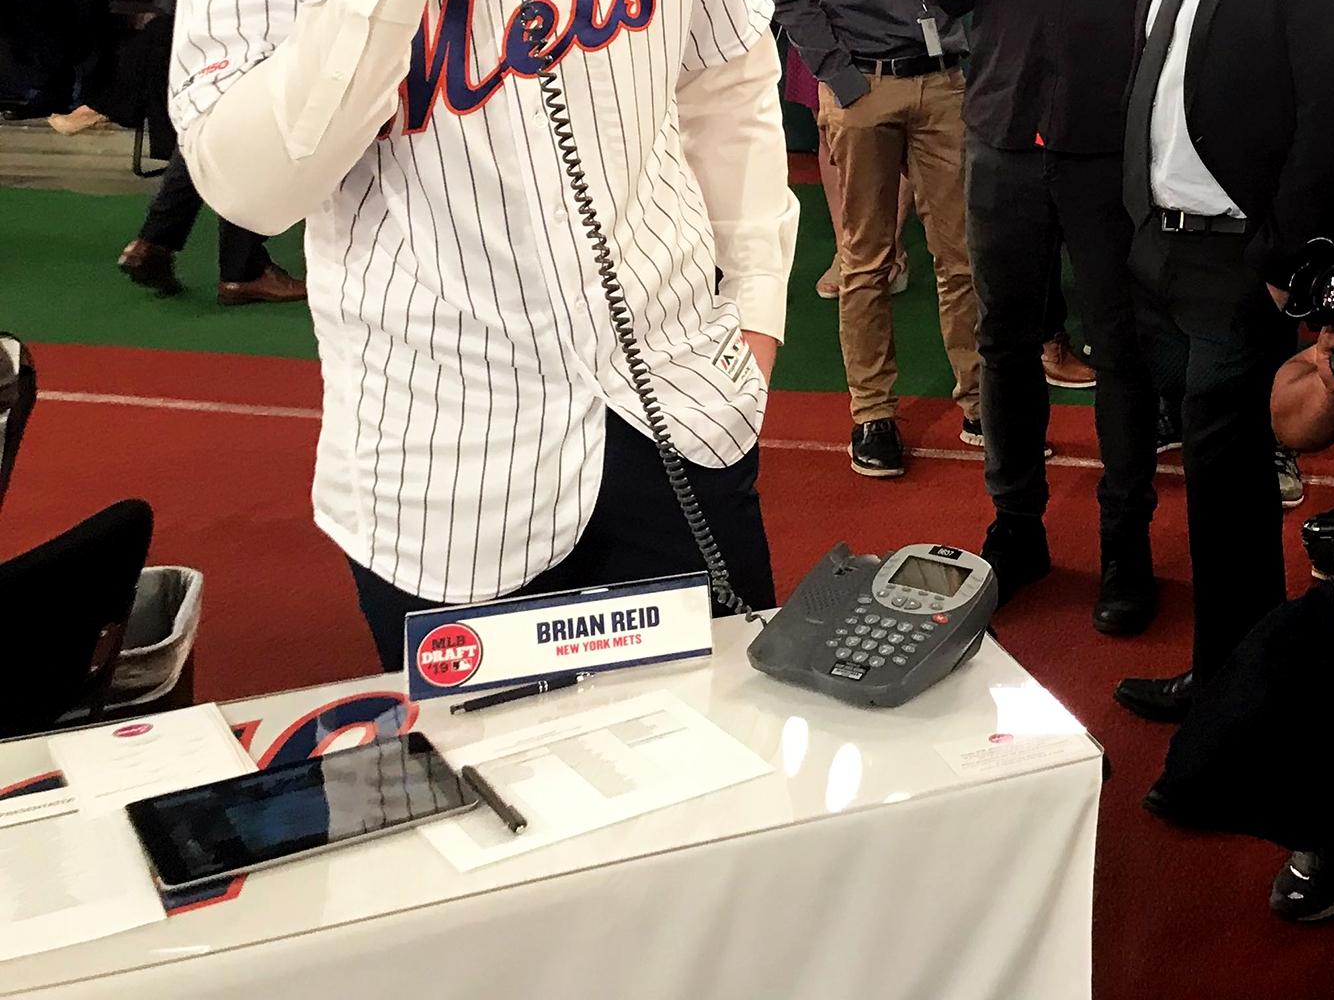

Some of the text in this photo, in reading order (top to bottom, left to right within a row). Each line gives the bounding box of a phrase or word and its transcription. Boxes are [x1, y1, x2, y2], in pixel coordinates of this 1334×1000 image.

[536, 605, 660, 644] BRIAN REID
[432, 634, 466, 650] MLB
[556, 634, 642, 657] NEW YORK METS
[421, 645, 477, 665] DRAFT
